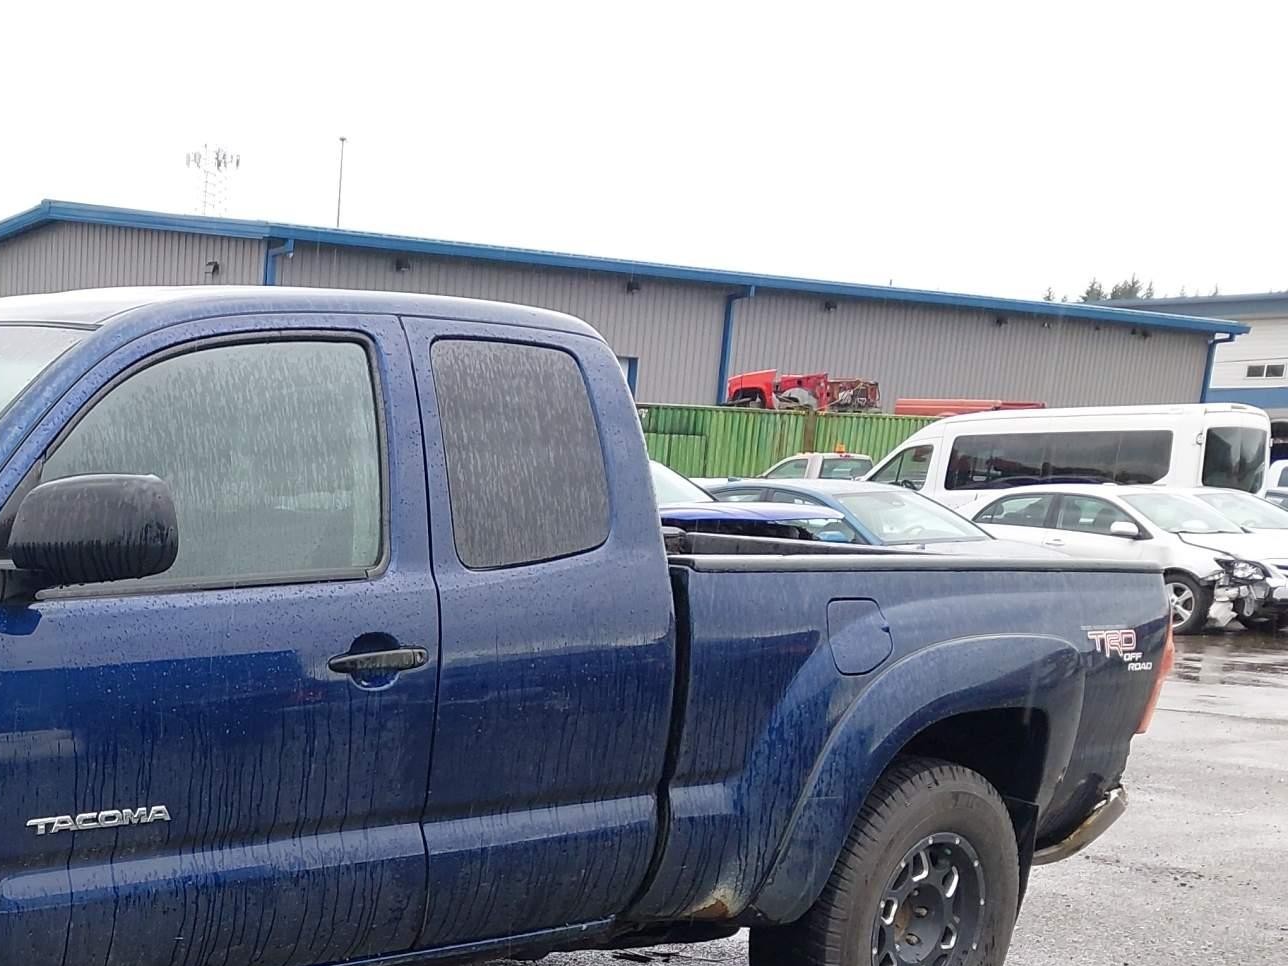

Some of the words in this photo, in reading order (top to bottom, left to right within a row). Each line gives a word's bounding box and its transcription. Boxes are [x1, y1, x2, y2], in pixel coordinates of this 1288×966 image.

[1087, 629, 1137, 658] TRD
[1123, 652, 1143, 662] OFF
[1127, 662, 1153, 671] ROAD
[26, 805, 172, 836] TACOMA
